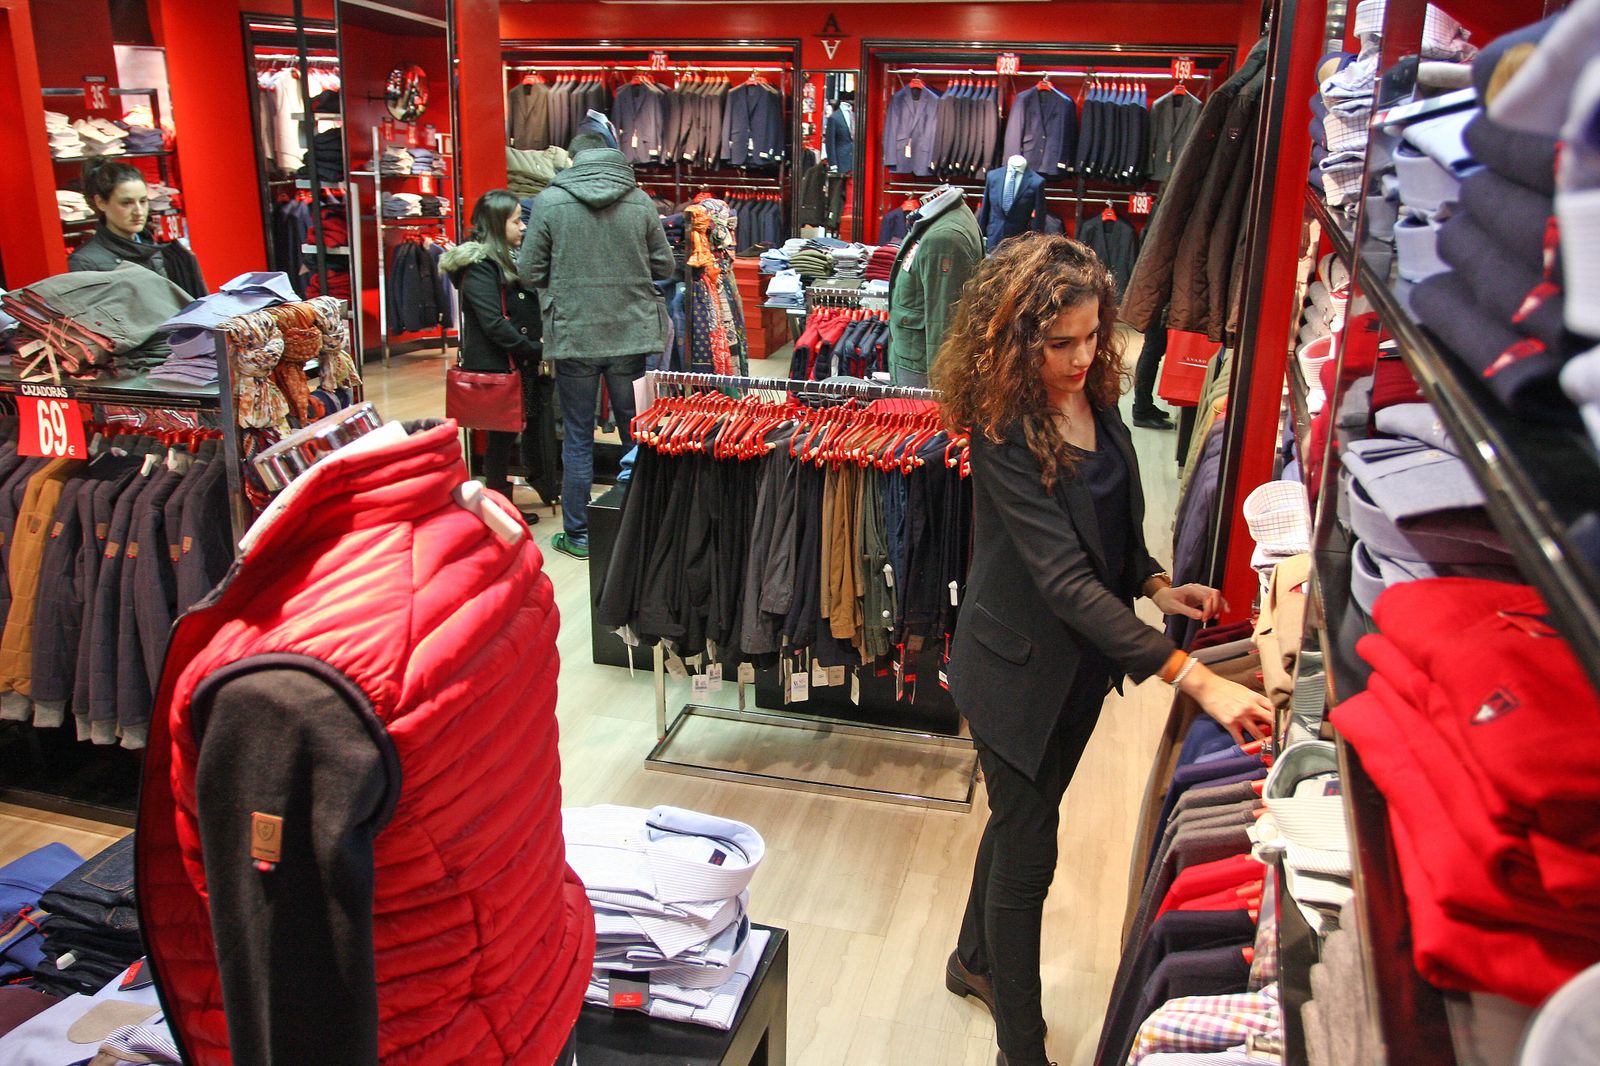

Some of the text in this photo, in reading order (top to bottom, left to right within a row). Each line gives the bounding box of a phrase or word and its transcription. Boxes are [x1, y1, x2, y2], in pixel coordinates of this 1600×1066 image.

[822, 12, 842, 33] A
[652, 54, 667, 71] 275
[1000, 57, 1015, 74] 239
[1175, 60, 1191, 79] 159
[90, 85, 105, 109] 35
[1133, 196, 1148, 214] 199
[21, 384, 69, 398] CAZADORAS
[37, 399, 67, 456] 69
[67, 445, 76, 456] €
